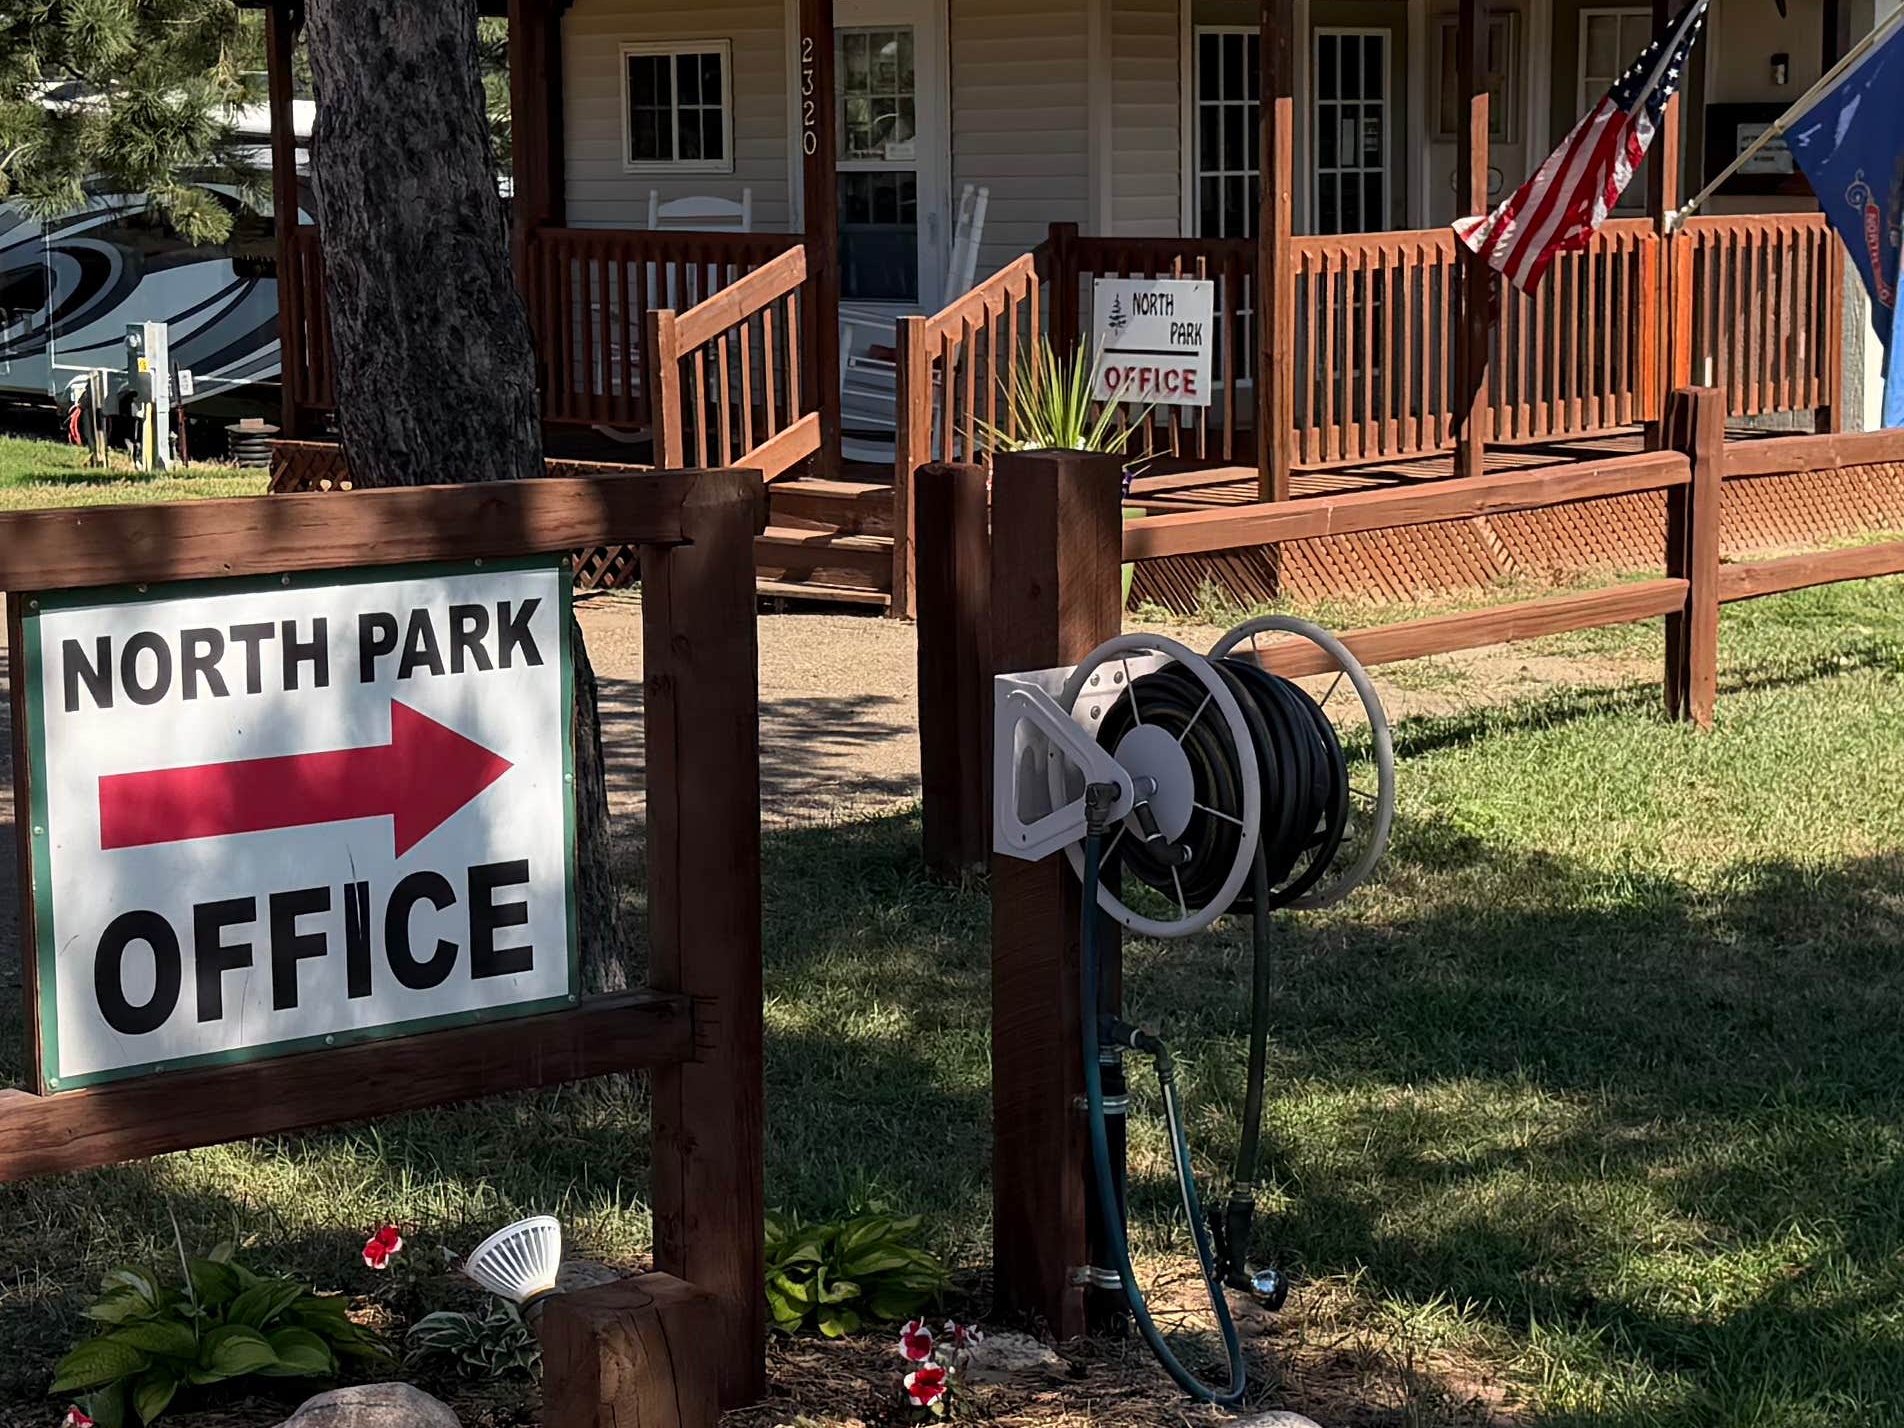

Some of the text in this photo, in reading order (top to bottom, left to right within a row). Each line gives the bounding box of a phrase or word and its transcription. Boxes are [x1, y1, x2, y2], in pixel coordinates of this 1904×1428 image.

[801, 37, 817, 155] 2320
[1132, 293, 1174, 316] NORTH
[1170, 322, 1203, 346] PARK
[1105, 366, 1197, 395] OFFICE
[62, 598, 544, 712] NORTH PARK
[94, 859, 534, 1035] OFFICE
